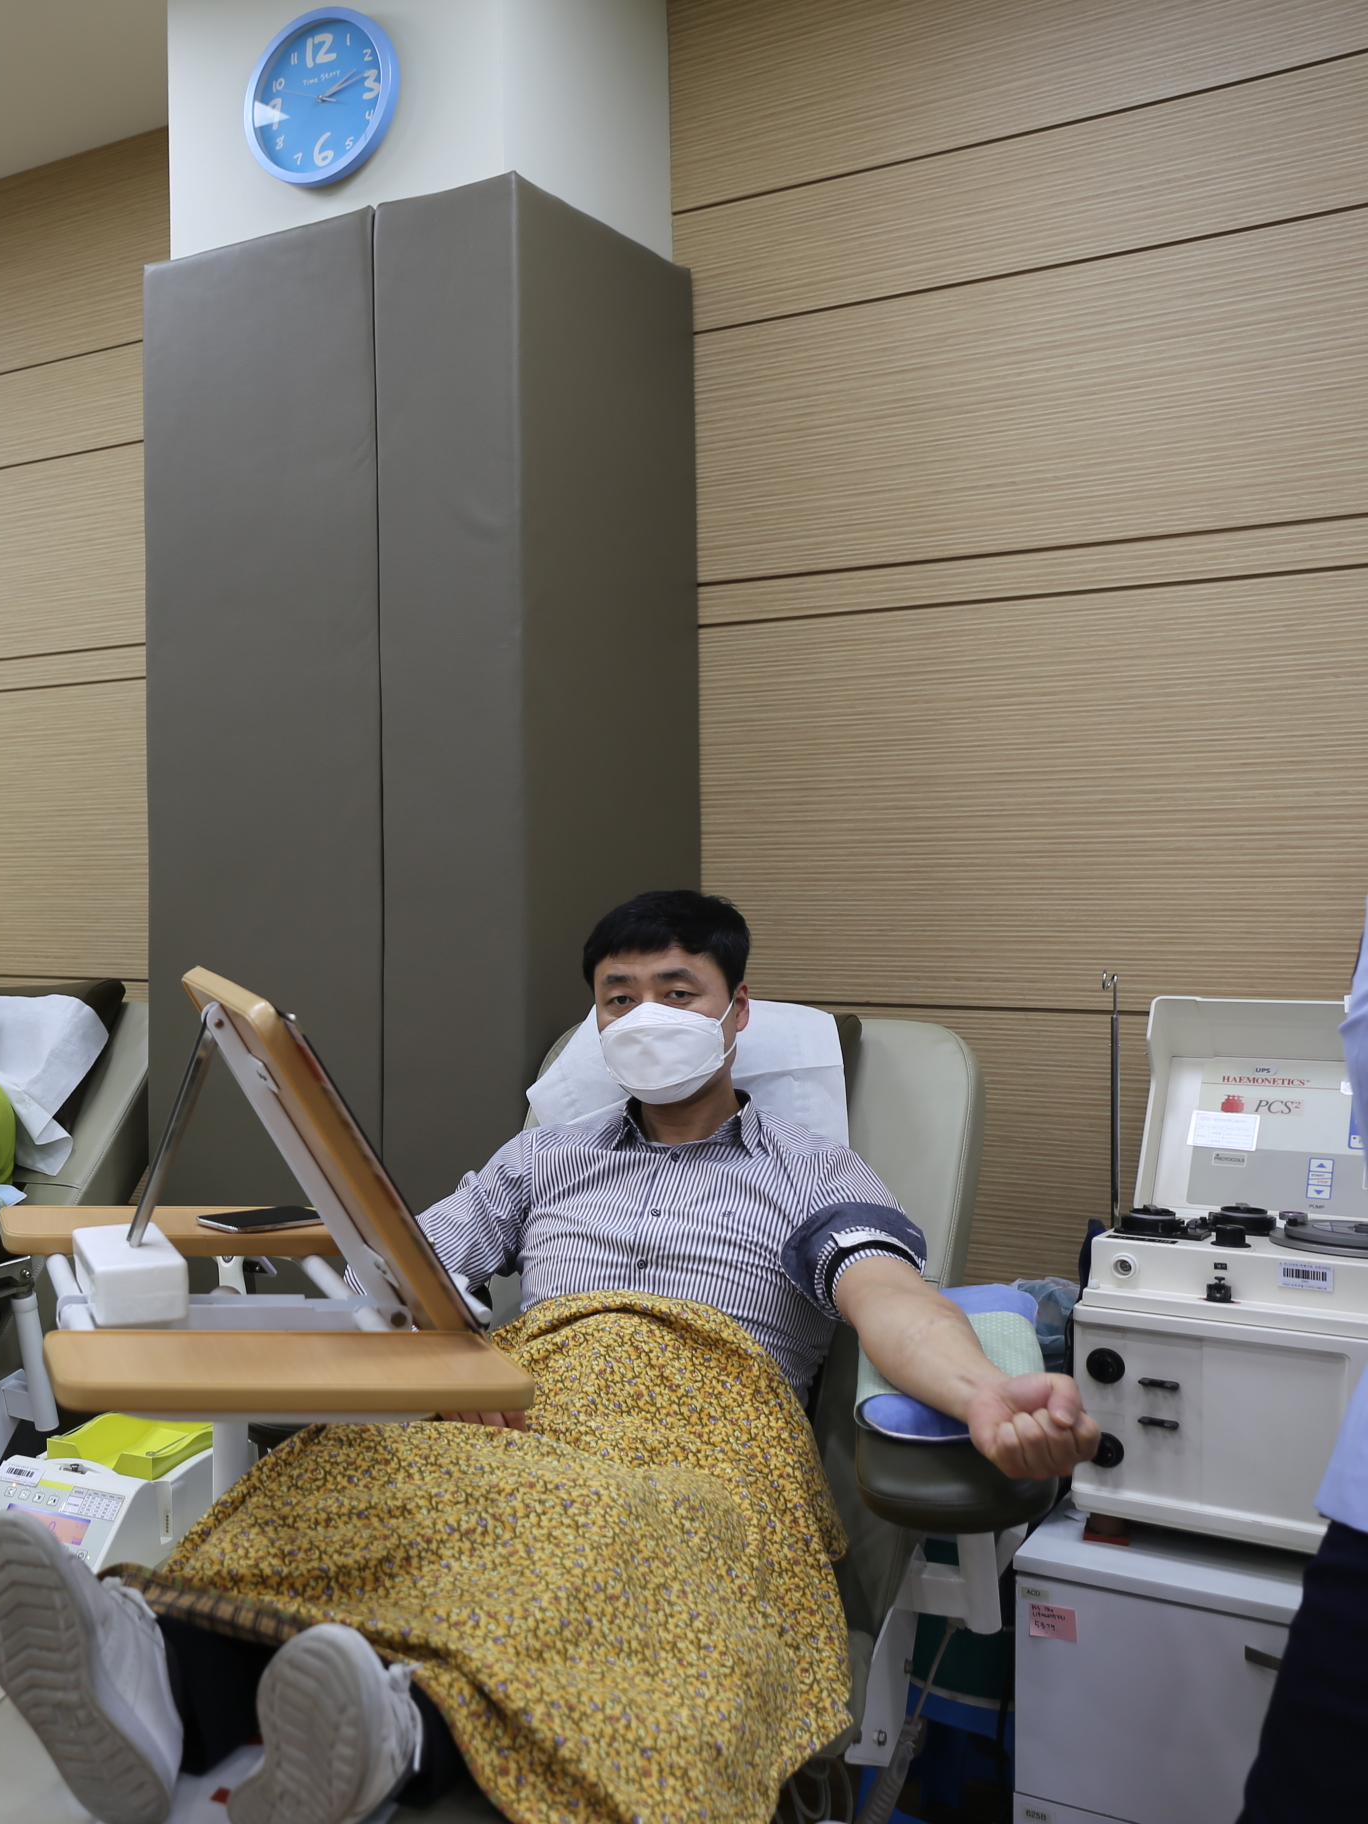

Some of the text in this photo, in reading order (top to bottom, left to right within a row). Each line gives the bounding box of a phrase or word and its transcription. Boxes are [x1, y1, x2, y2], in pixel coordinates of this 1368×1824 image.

[346, 33, 351, 46] 1
[305, 33, 337, 68] 12
[363, 48, 373, 61] 2
[290, 51, 298, 65] 11
[303, 69, 341, 86] Time Story
[362, 69, 380, 100] 3
[272, 77, 285, 93] 10
[266, 98, 282, 131] 9
[365, 110, 374, 122] 4
[275, 135, 285, 150] 8
[313, 132, 335, 167] 6
[345, 137, 354, 150] 5
[293, 152, 303, 165] 7
[1026, 1589, 1041, 1597] ACD
